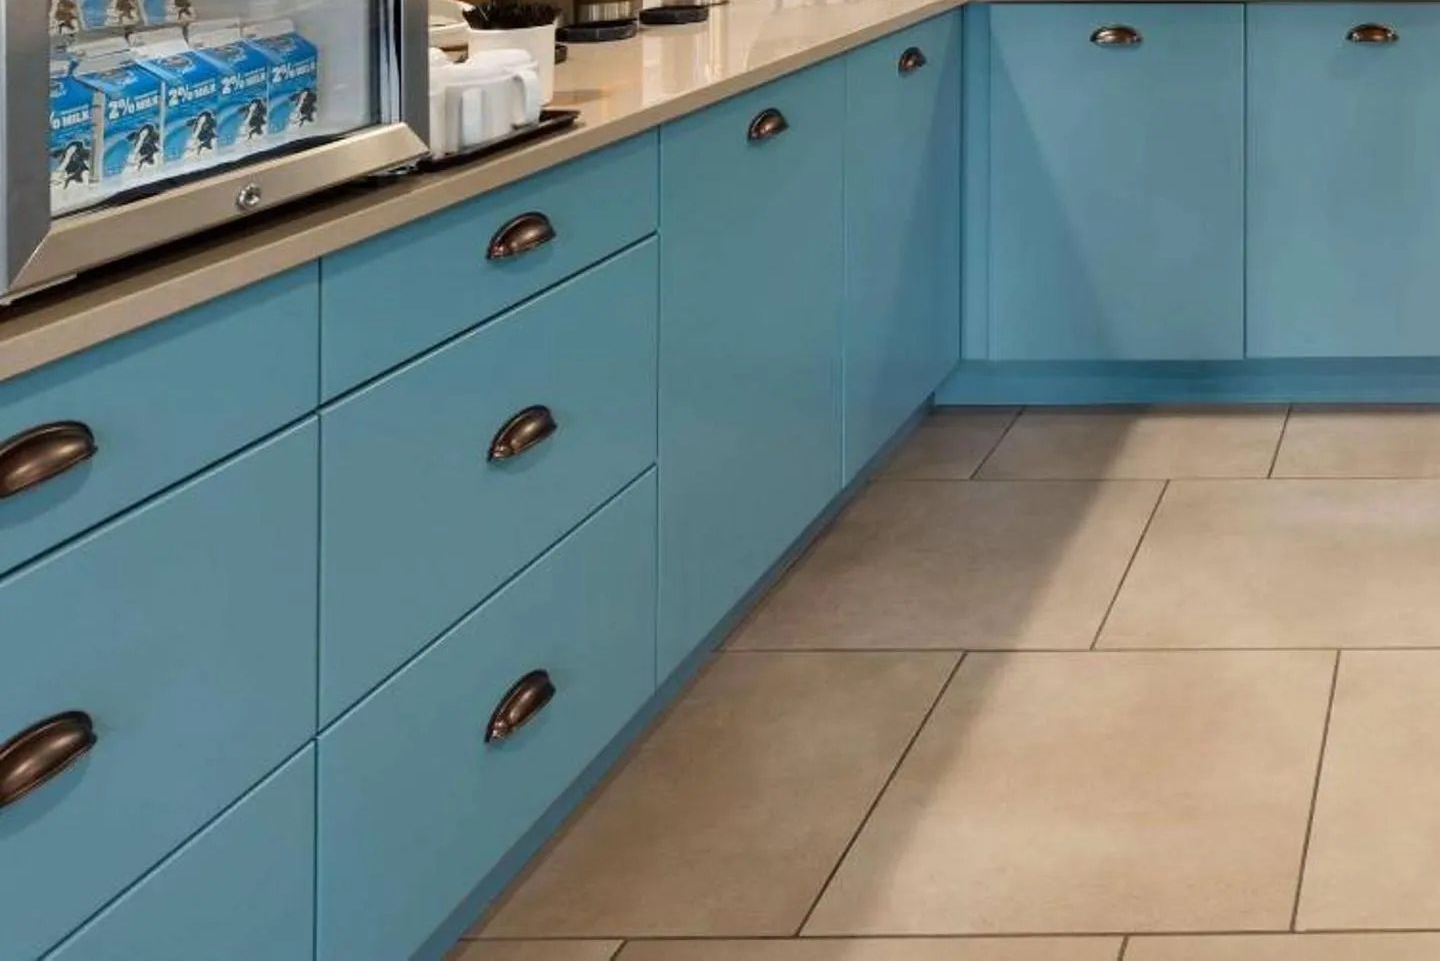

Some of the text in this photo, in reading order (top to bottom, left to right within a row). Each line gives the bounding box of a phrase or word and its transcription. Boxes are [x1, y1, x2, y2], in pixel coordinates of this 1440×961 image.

[220, 72, 245, 95] 2%
[270, 60, 297, 84] 2%
[168, 85, 193, 107] 2%
[108, 97, 135, 120] 2%
